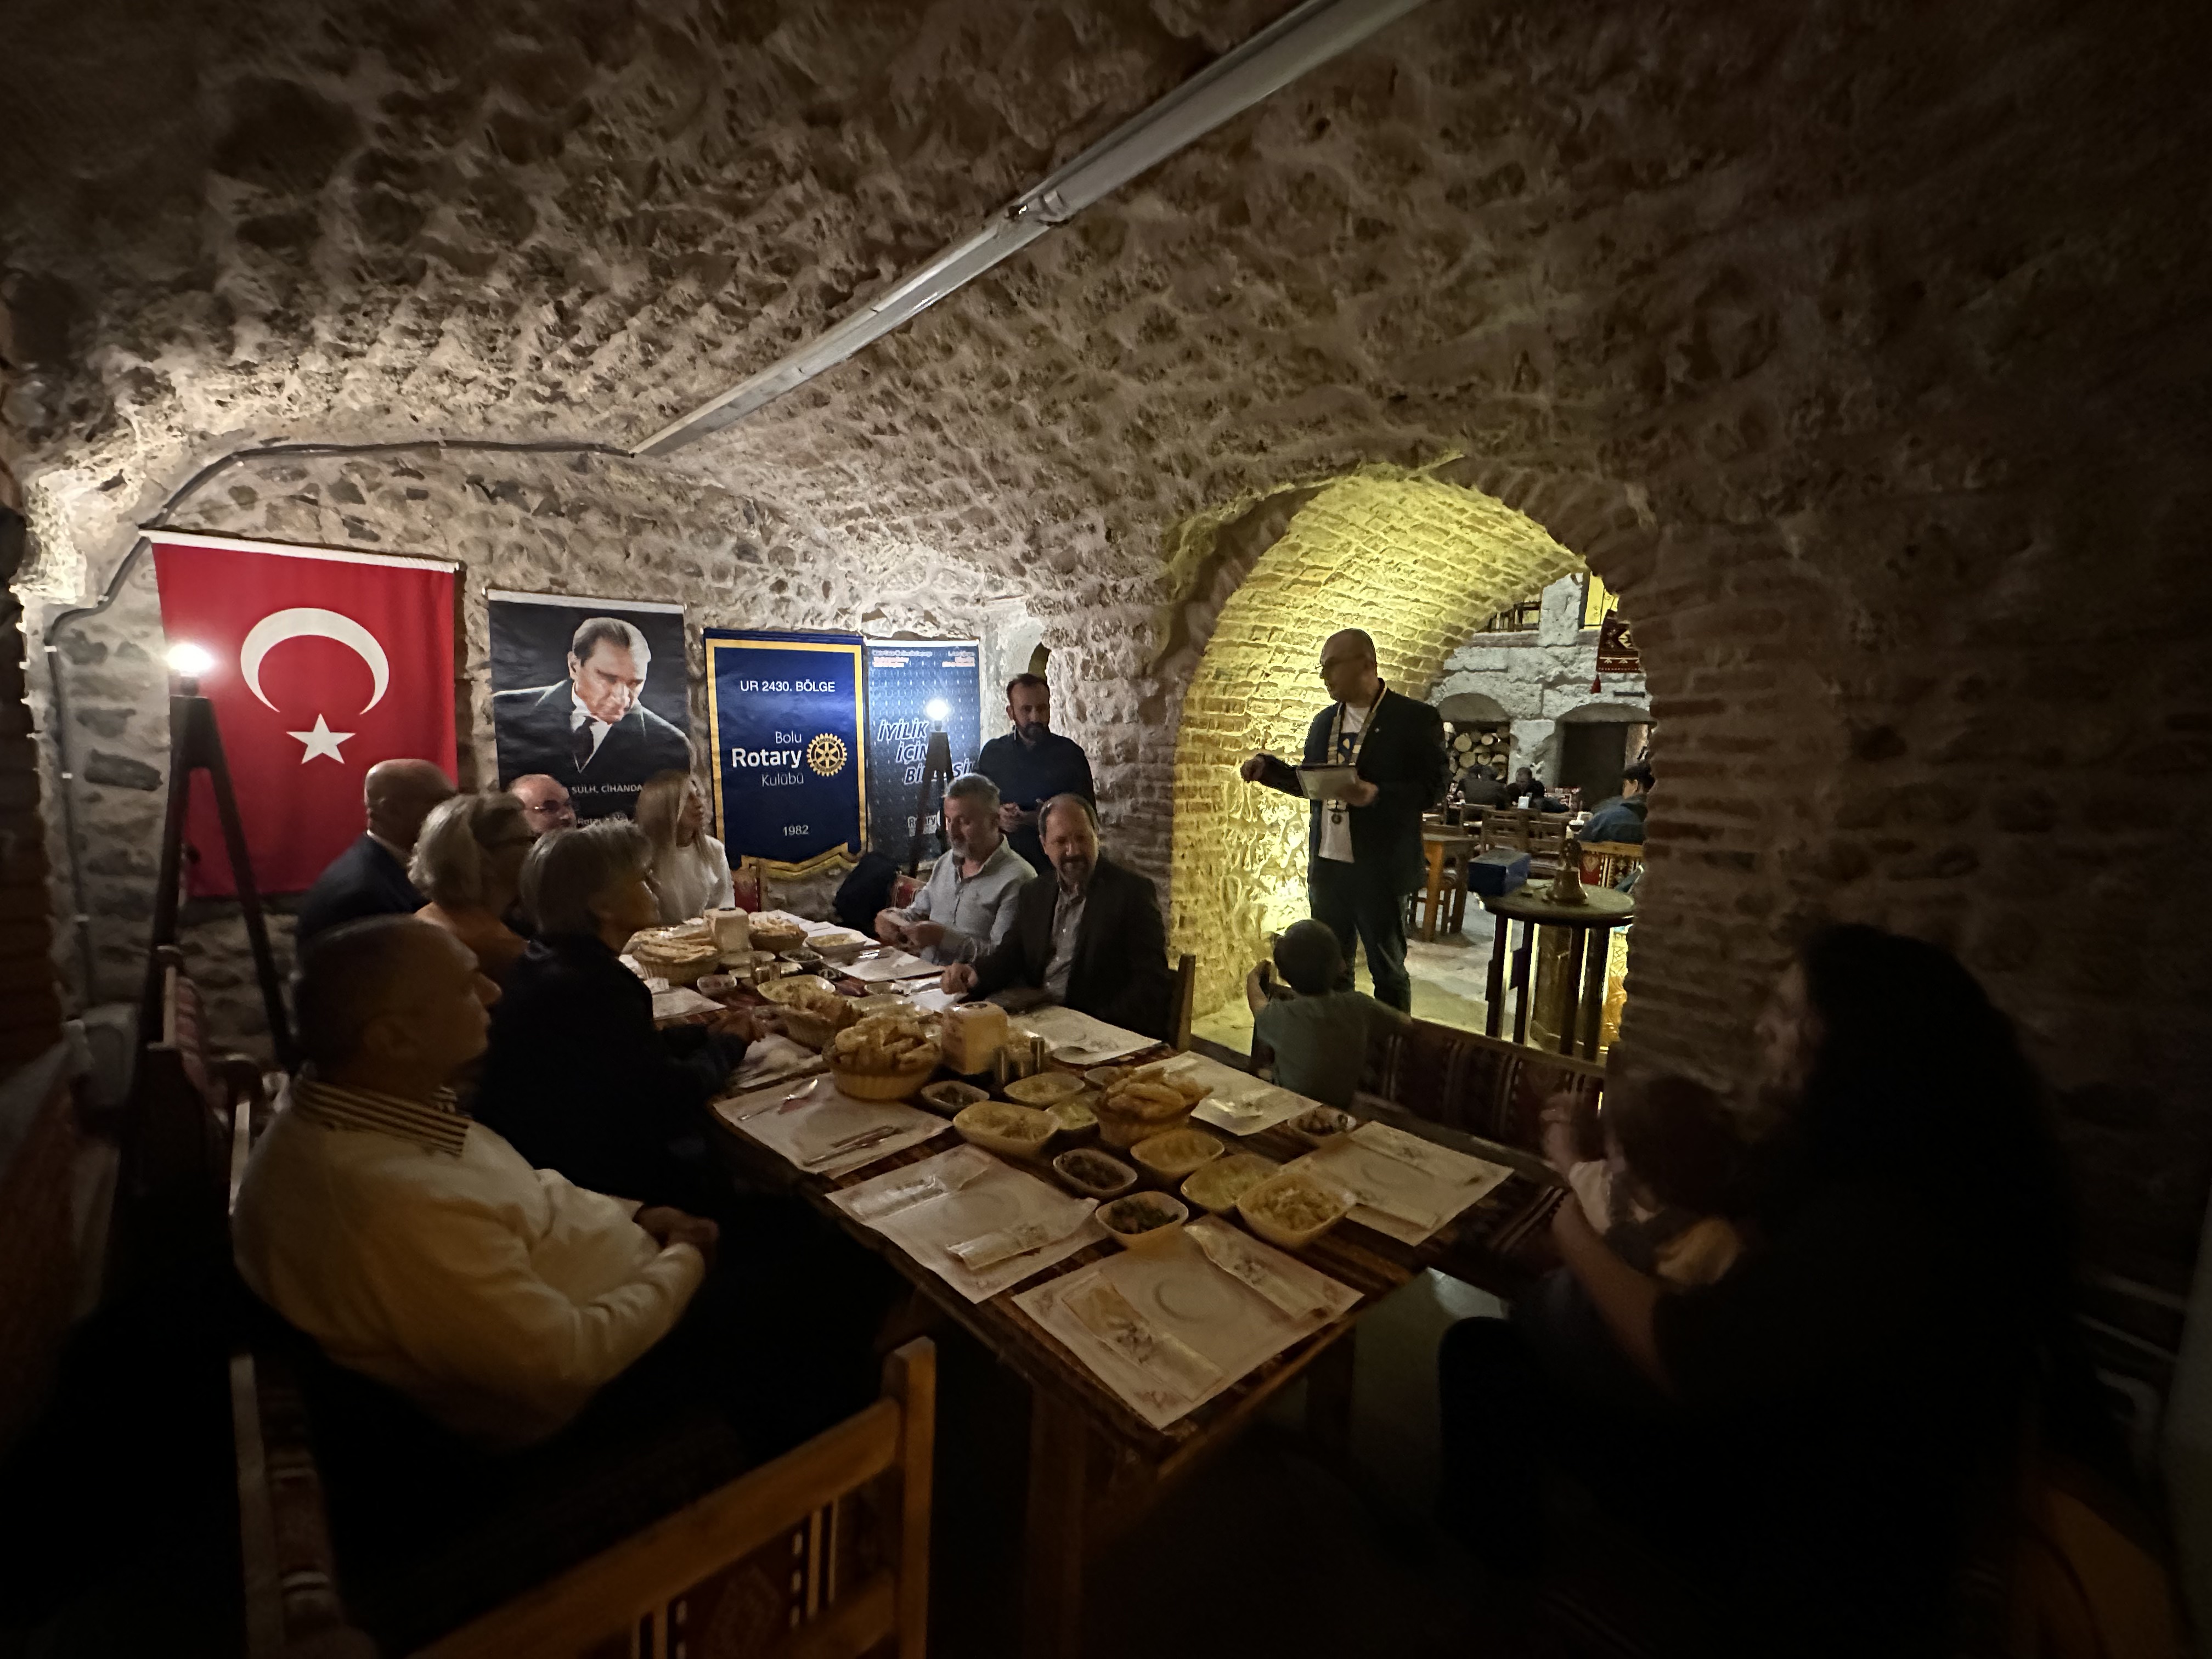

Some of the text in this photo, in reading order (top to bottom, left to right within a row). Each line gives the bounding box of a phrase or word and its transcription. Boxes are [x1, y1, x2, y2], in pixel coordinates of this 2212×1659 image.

[740, 679, 836, 692] UR 2430. BÖLGE
[878, 719, 929, 741] İYİLİK
[775, 731, 802, 744] Bolu
[732, 748, 802, 769] Rotary
[761, 773, 804, 786] Kulübü
[783, 825, 809, 836] 1982
